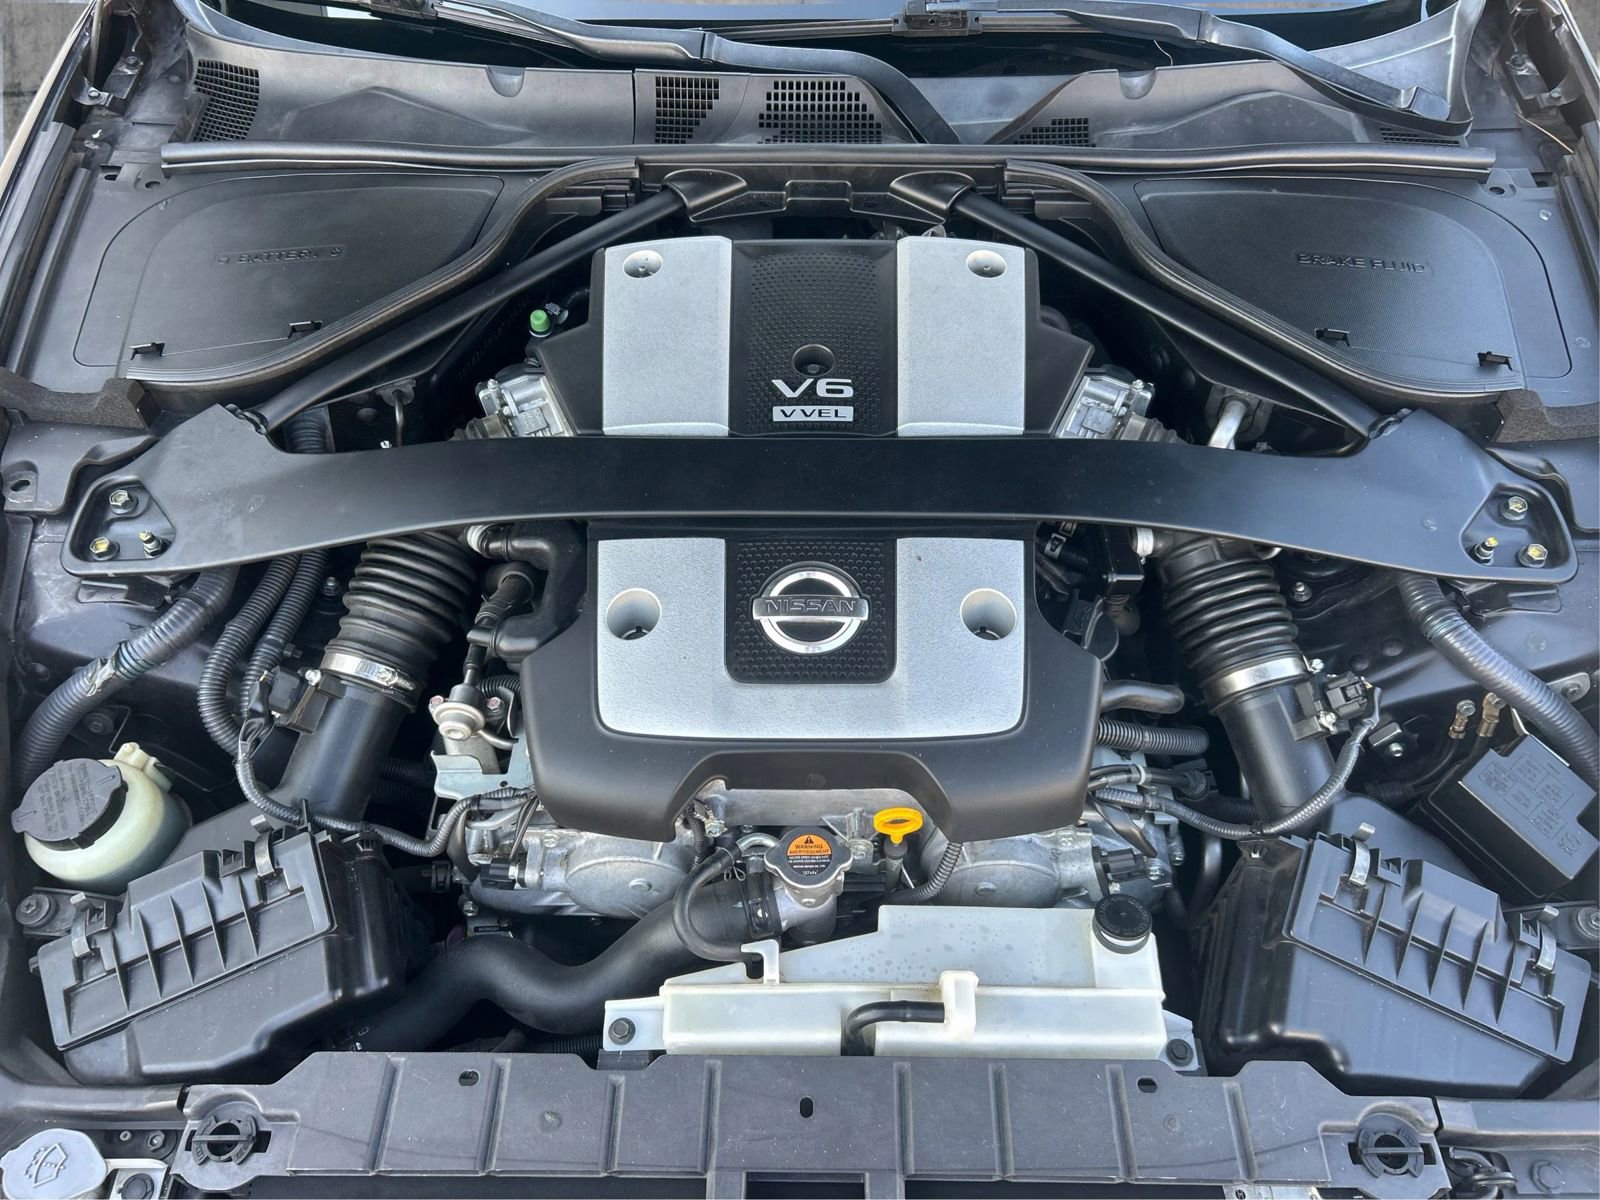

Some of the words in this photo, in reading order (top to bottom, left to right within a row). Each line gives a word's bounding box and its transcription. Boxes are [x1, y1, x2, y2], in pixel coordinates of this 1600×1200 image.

[1297, 253, 1367, 268] BRAKE
[1371, 259, 1425, 273] FLUID
[771, 378, 854, 398] V6
[780, 408, 847, 418] VVEL
[765, 599, 856, 613] NISSAN
